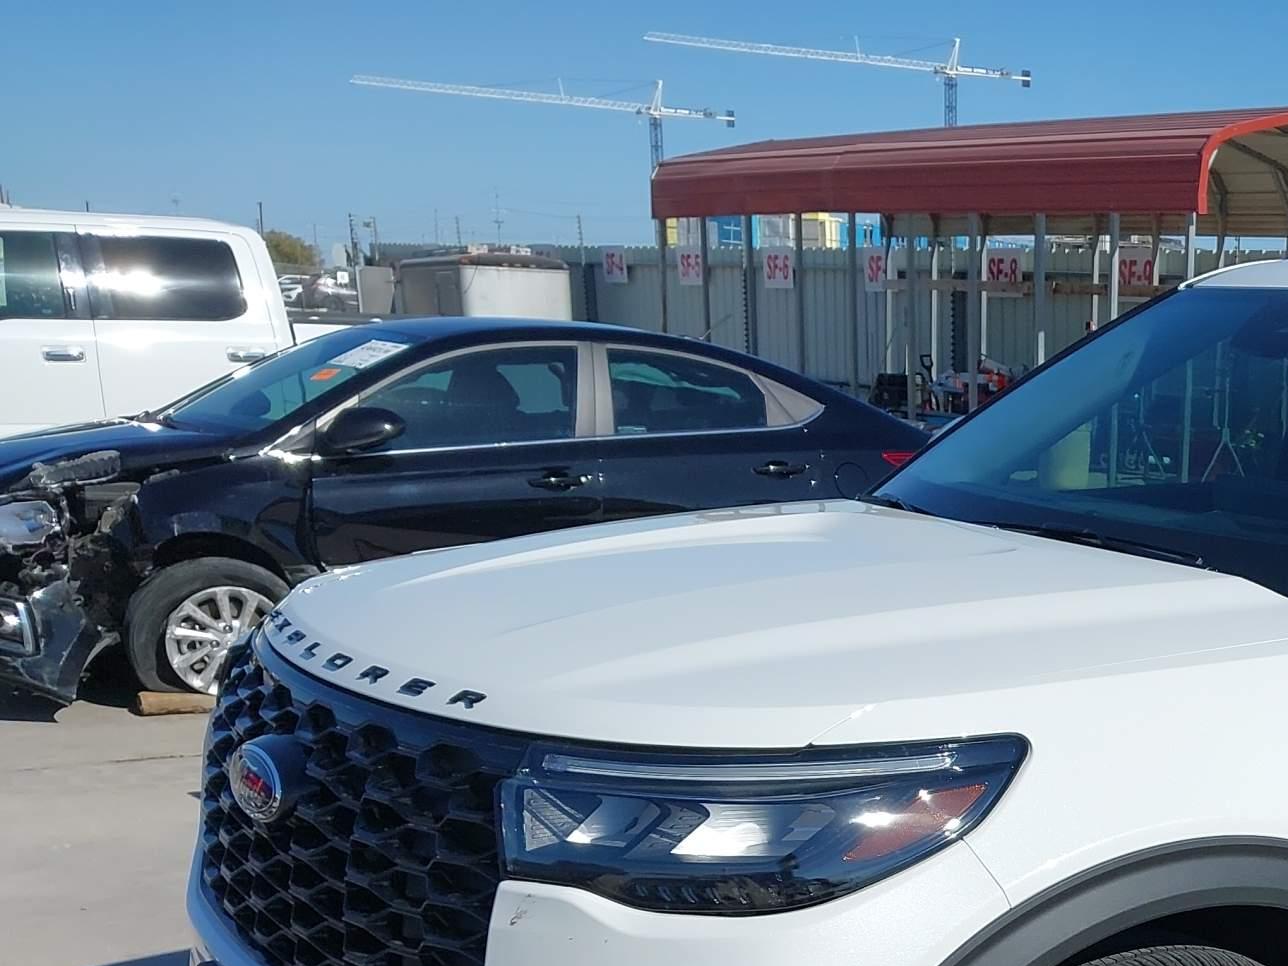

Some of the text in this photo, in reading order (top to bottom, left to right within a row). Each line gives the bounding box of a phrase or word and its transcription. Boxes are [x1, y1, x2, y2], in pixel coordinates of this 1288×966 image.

[605, 252, 625, 276] SF-4
[680, 253, 701, 278] SF-5
[766, 254, 790, 281] SF-6
[867, 254, 886, 283] SF-
[988, 257, 1019, 284] SF-8
[1118, 258, 1154, 286] SF-9
[269, 610, 488, 710] EXPLORER
